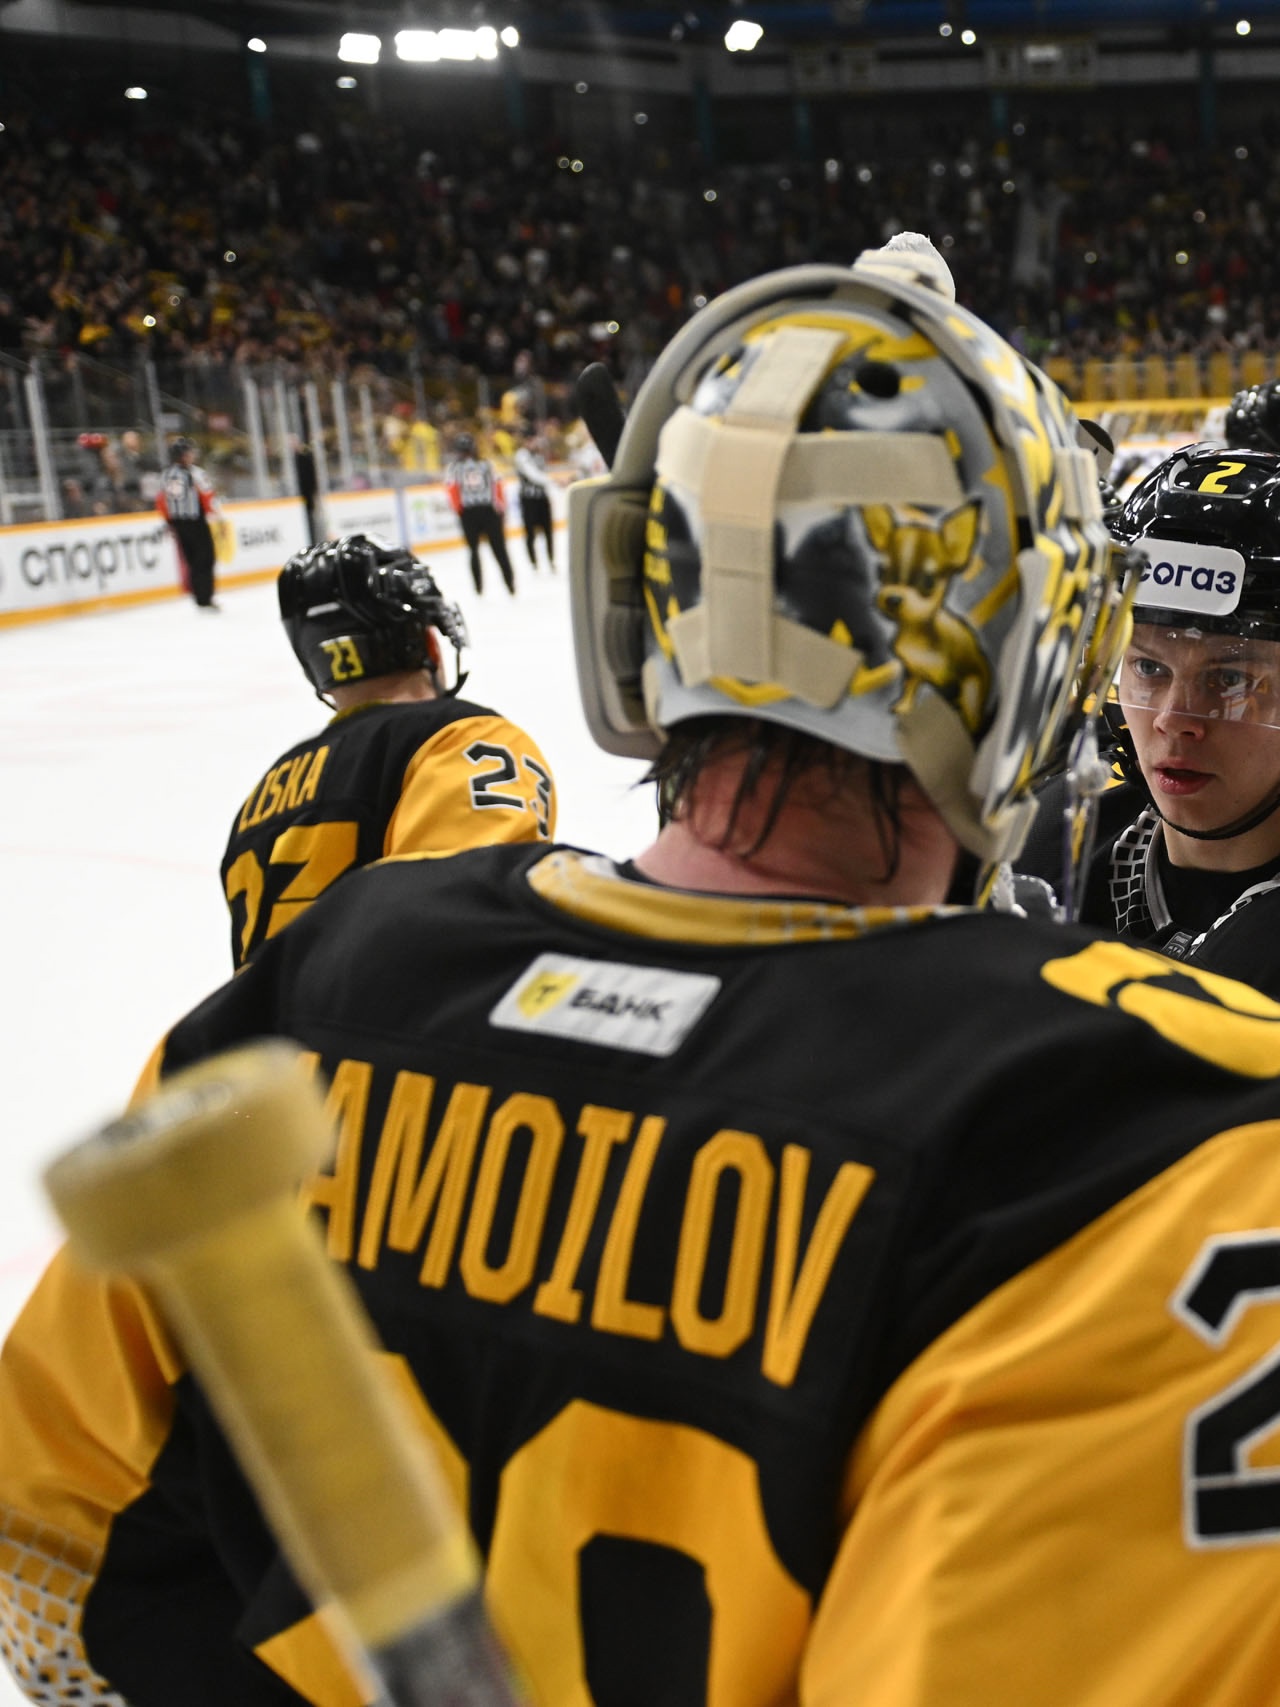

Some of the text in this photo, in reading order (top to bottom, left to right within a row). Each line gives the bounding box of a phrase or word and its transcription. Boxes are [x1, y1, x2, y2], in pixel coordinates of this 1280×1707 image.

[1197, 461, 1247, 494] 2
[319, 636, 364, 681] 23
[568, 988, 672, 1021] БАНК
[302, 1050, 877, 1388] AMOILOV
